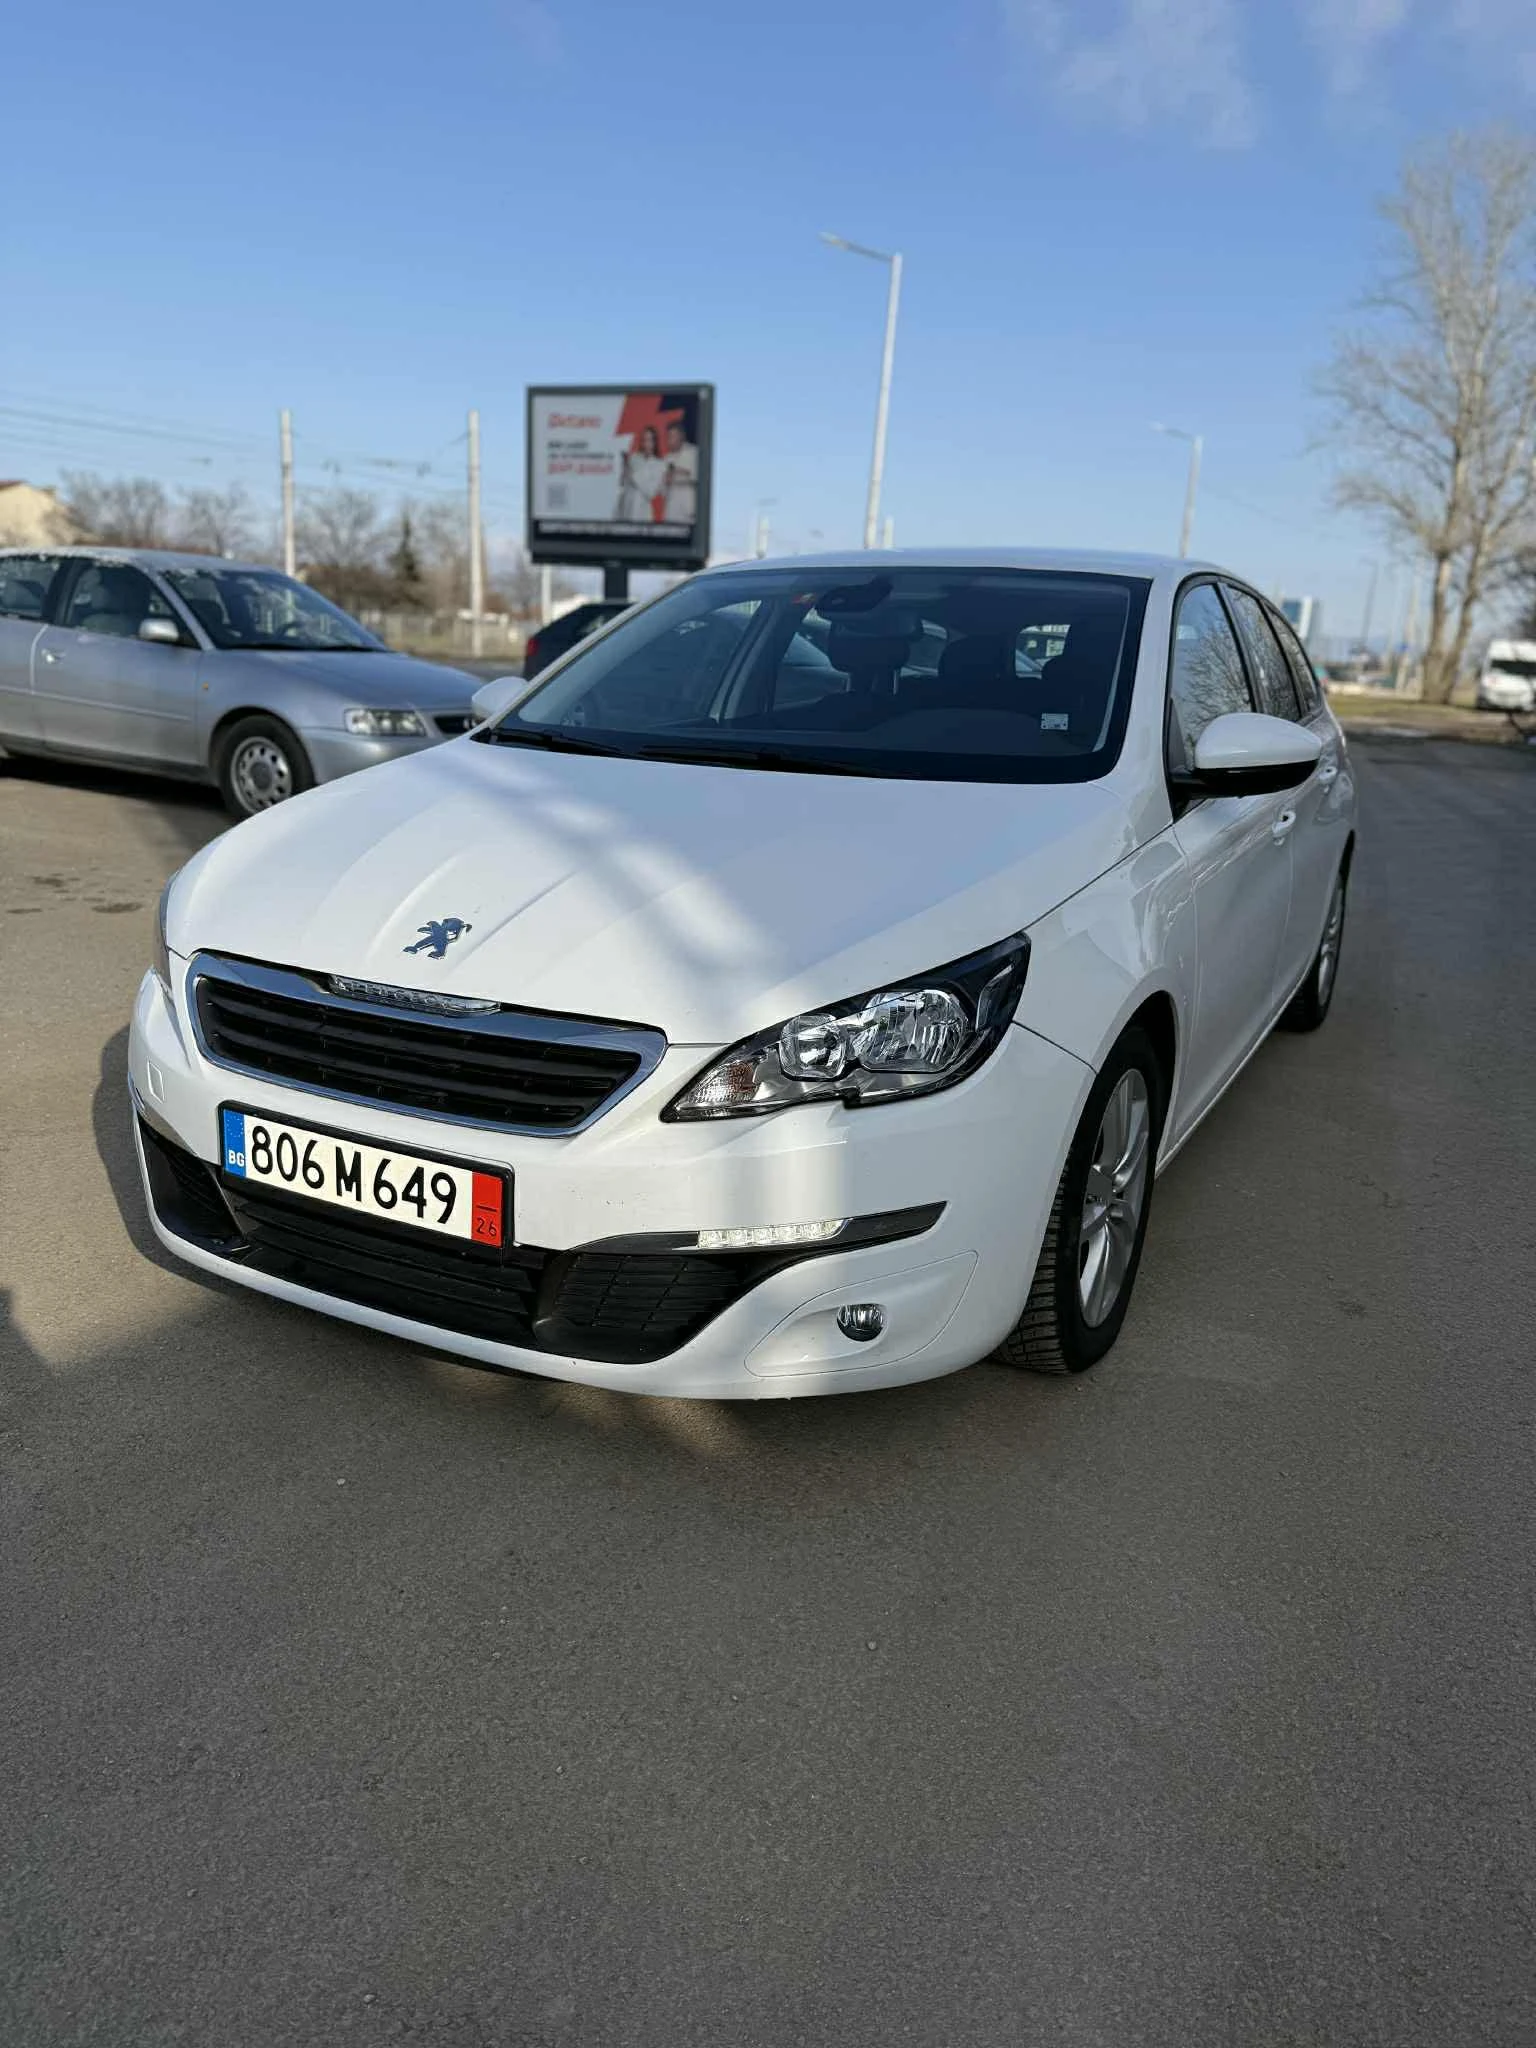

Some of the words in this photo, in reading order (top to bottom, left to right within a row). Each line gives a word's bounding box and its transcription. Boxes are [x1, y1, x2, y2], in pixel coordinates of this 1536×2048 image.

[228, 1149, 245, 1167] BG
[251, 1125, 325, 1190] 806
[335, 1146, 362, 1202] M
[373, 1157, 457, 1225] 649
[475, 1216, 498, 1238] 26
